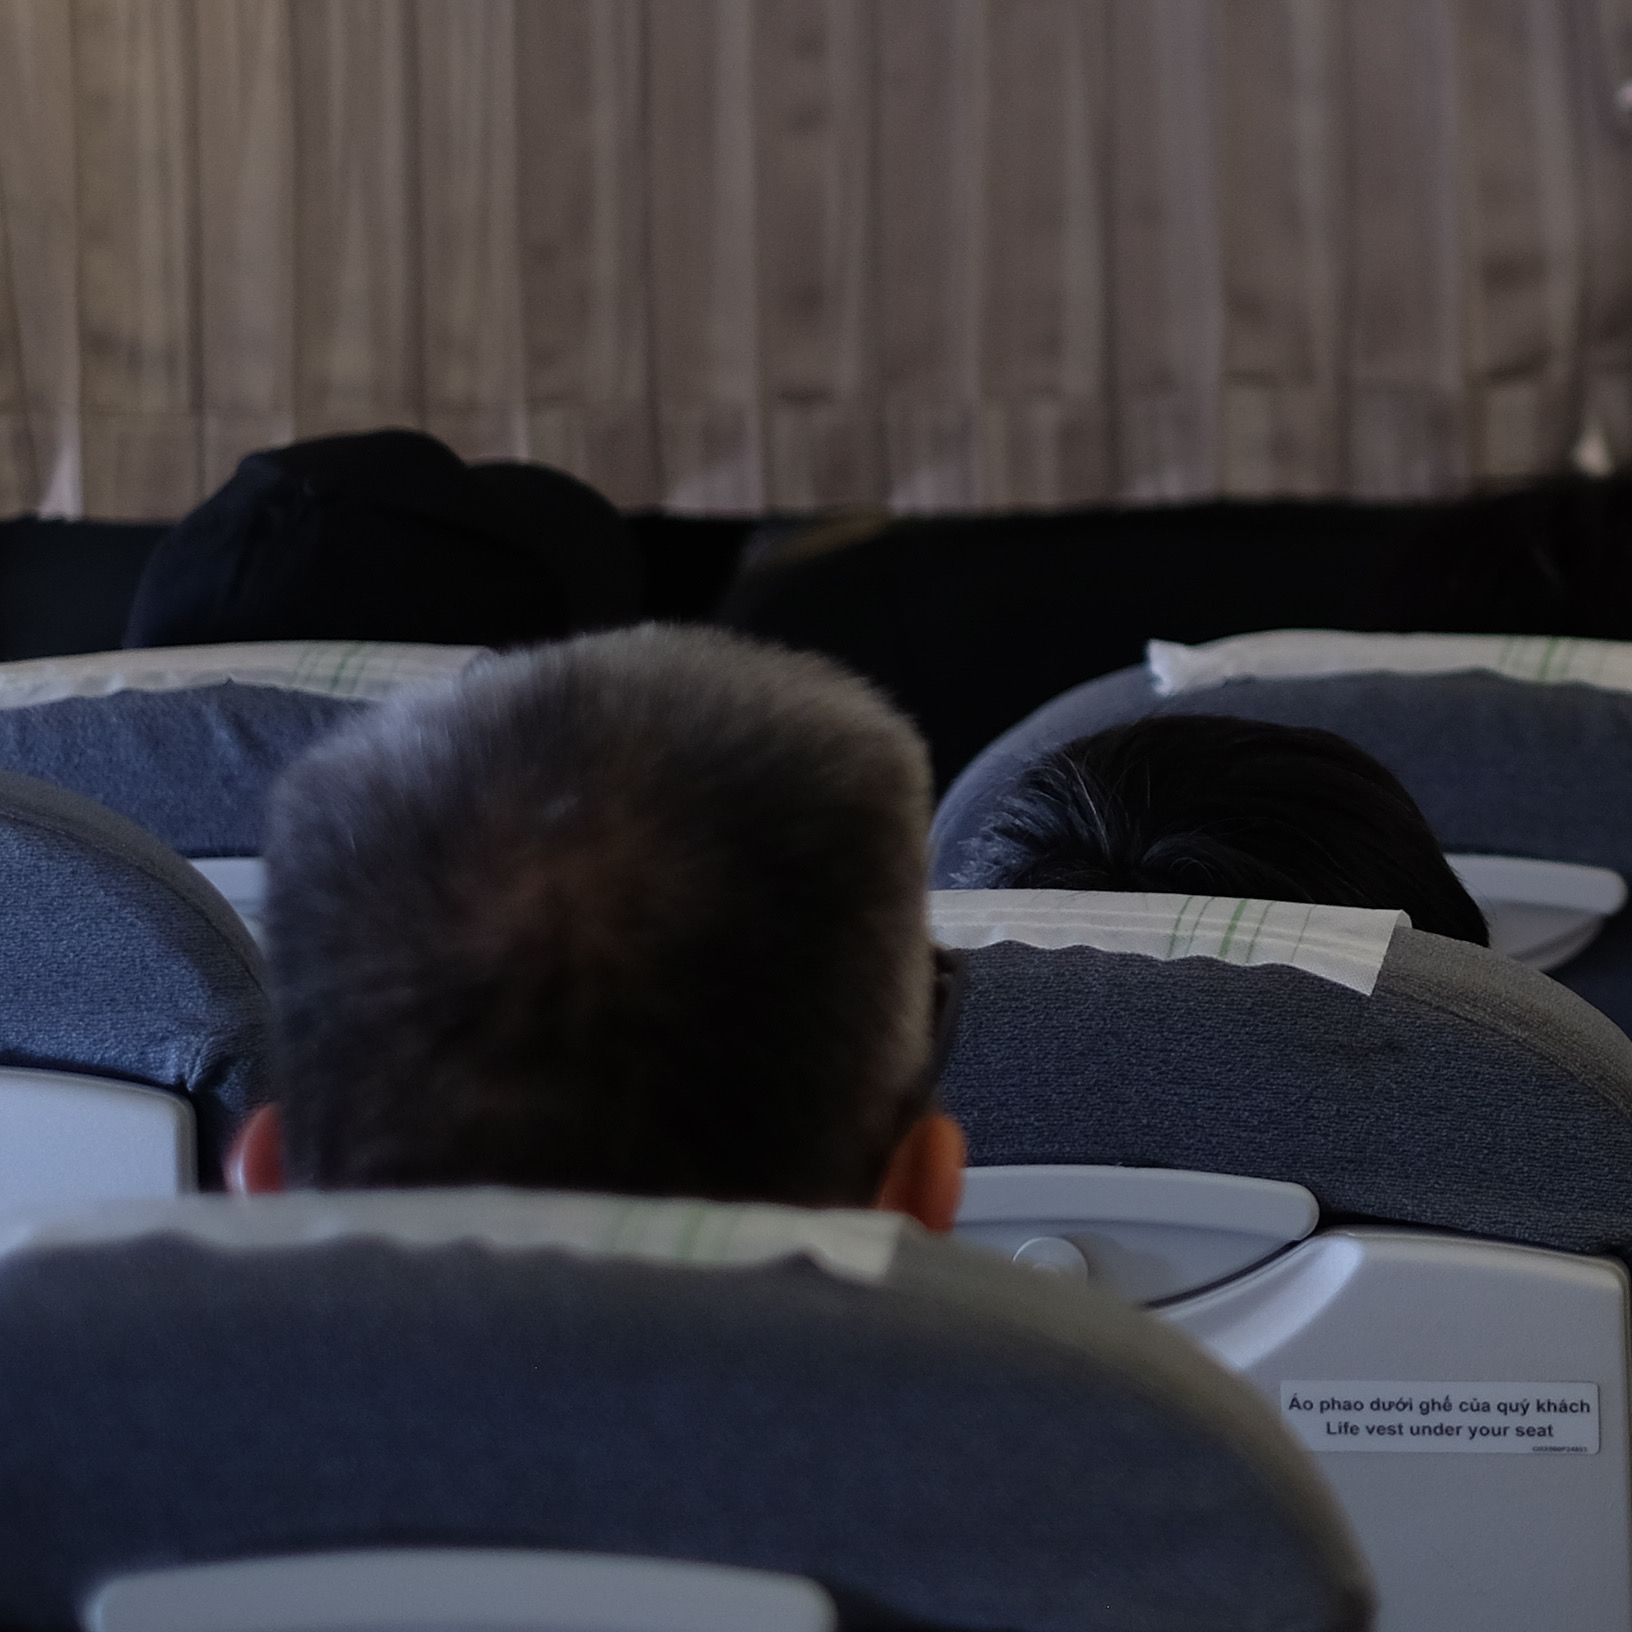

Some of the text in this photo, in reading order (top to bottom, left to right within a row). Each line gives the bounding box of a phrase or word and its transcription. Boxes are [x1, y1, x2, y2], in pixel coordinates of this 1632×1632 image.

[1288, 1393, 1591, 1416] Áo phao dưới ghế của quý khách
[1326, 1421, 1554, 1440] Life vest under your seat
